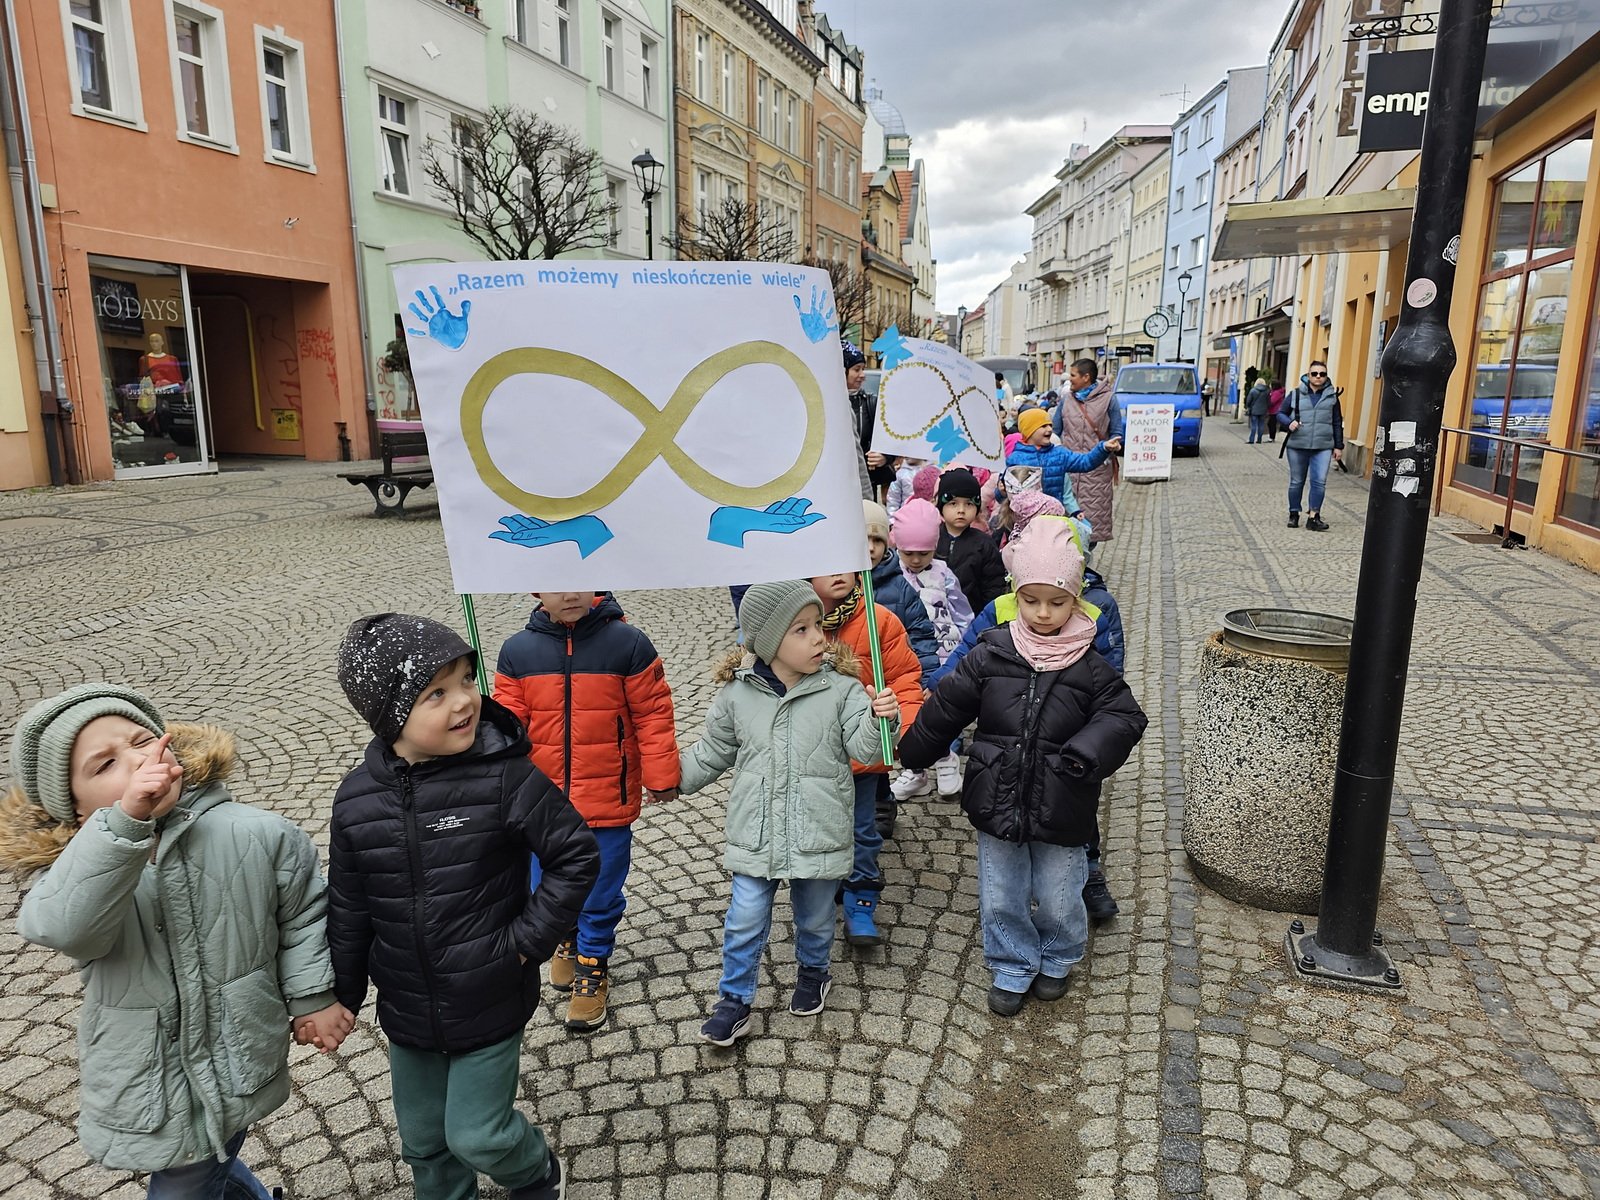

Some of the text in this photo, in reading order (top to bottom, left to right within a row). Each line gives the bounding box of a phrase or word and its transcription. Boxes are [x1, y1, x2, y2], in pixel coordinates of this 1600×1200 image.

[1368, 91, 1430, 116] emp
[449, 272, 525, 294] „Razem
[538, 267, 618, 288] możemy
[632, 268, 752, 285] nieskończenie
[1130, 418, 1169, 426] KANTOR
[1132, 434, 1158, 445] 4,20
[1131, 452, 1157, 462] 3,96
